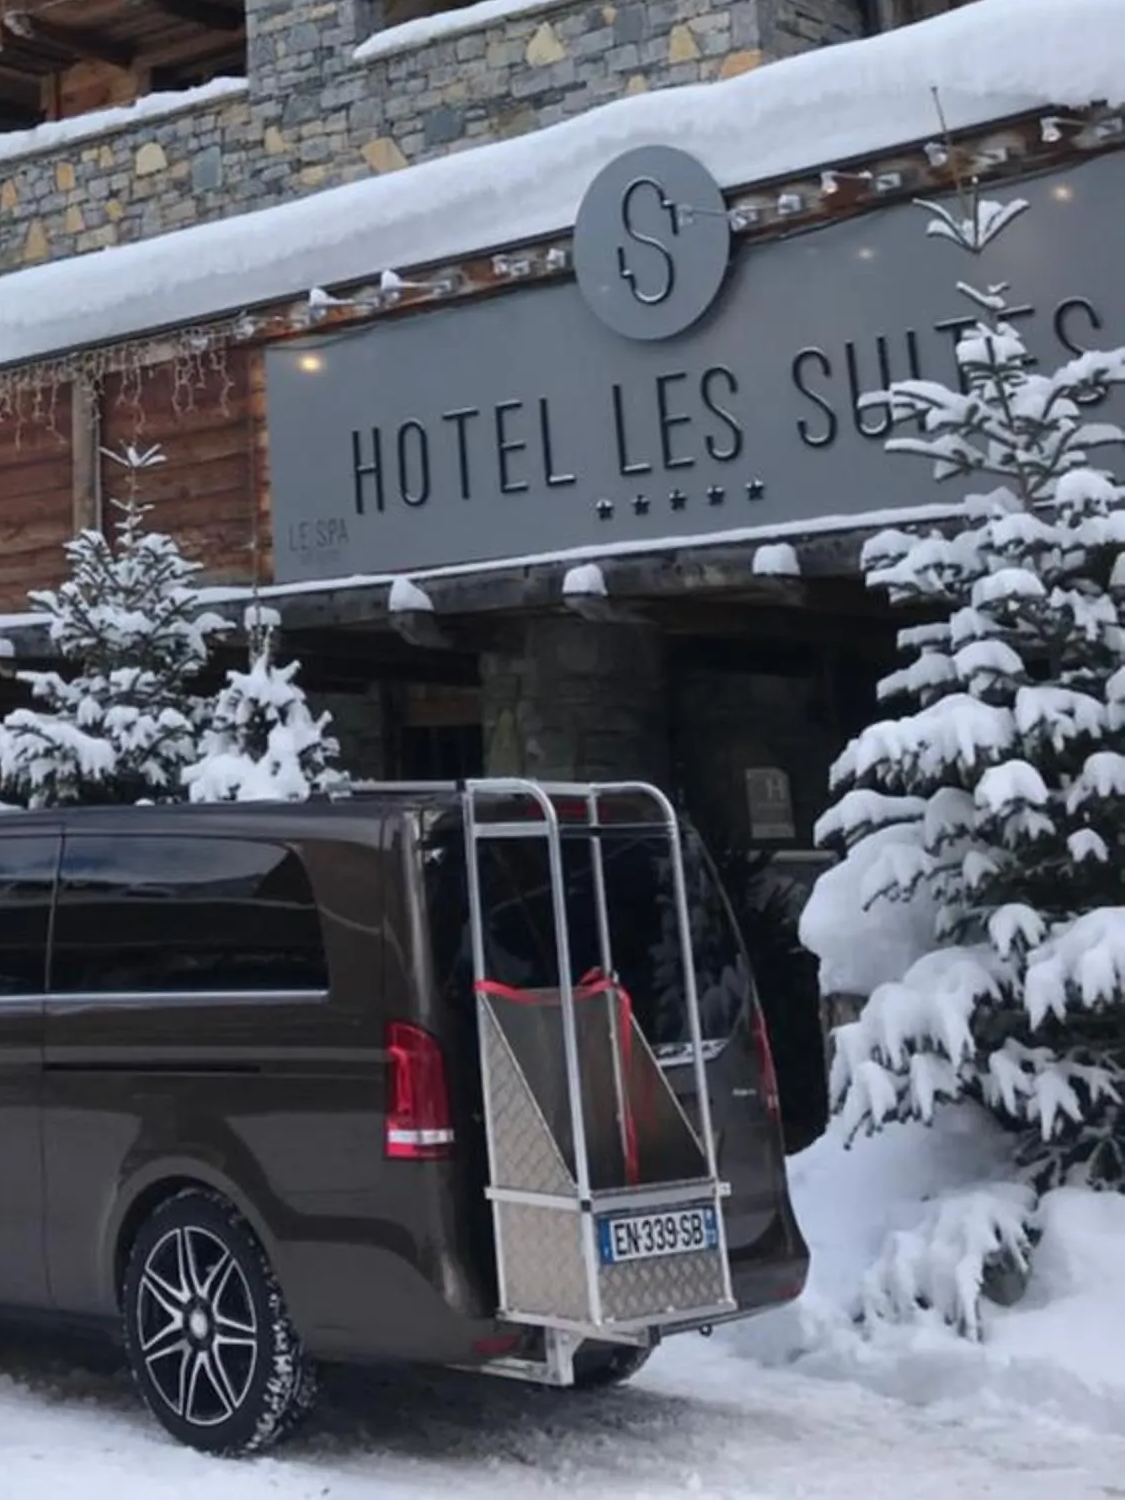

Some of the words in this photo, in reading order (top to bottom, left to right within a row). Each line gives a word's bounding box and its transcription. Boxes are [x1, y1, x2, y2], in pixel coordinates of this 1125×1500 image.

[352, 396, 576, 514] HOTEL
[612, 365, 745, 477] LES
[792, 296, 1111, 447] SUITS
